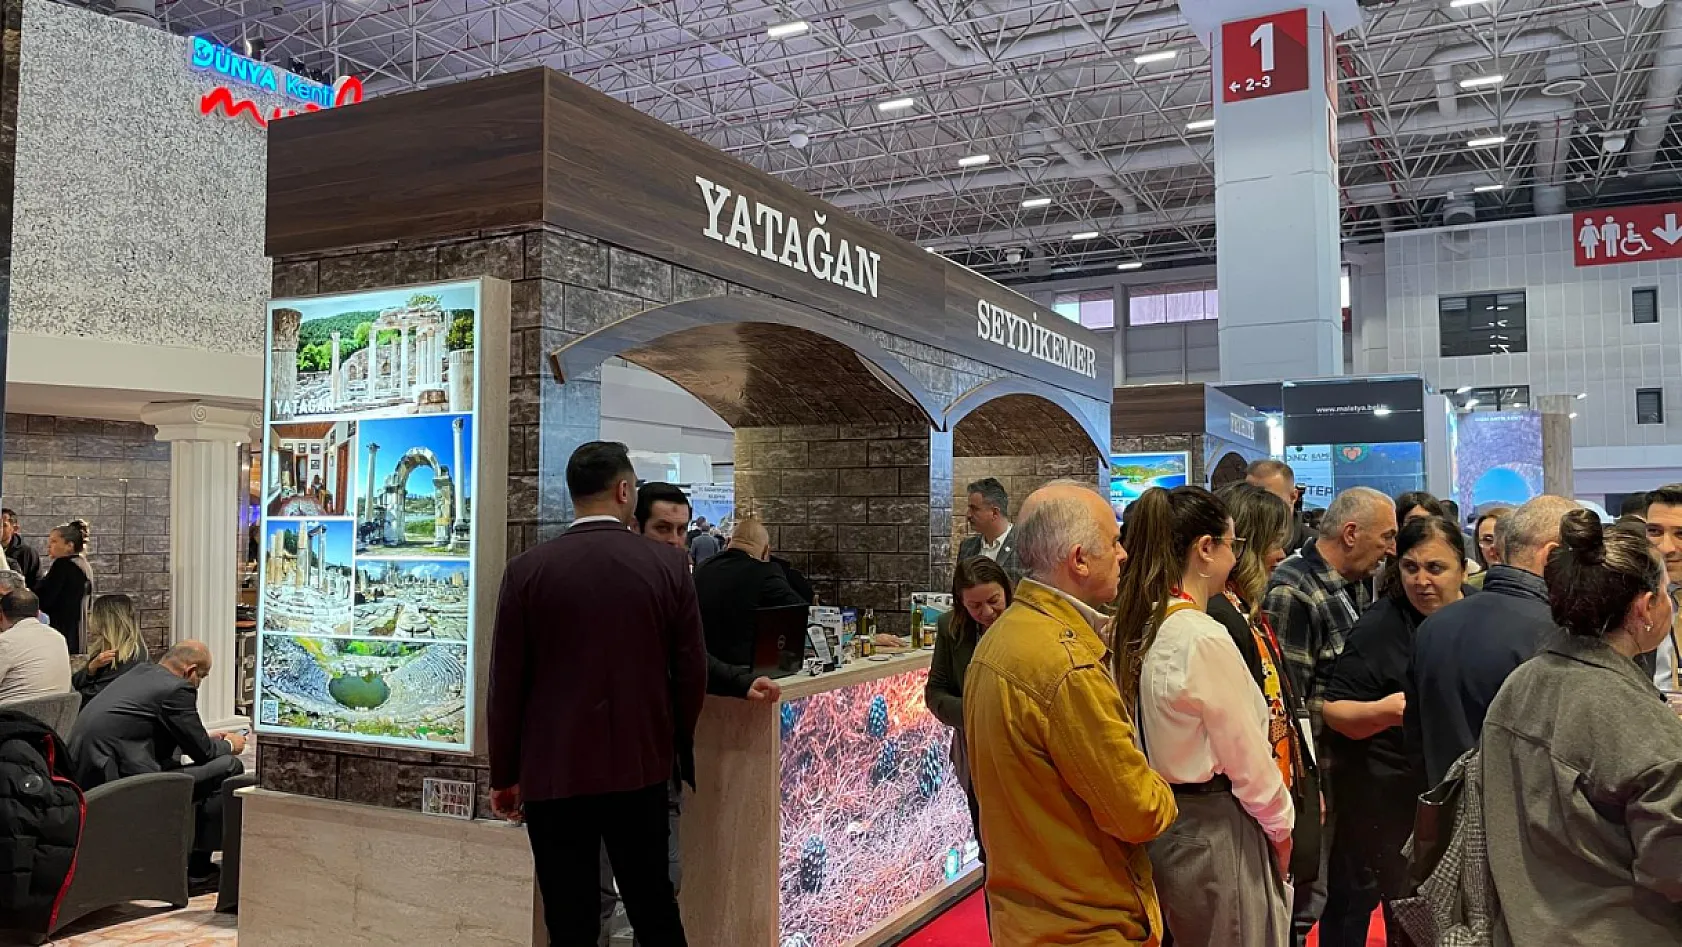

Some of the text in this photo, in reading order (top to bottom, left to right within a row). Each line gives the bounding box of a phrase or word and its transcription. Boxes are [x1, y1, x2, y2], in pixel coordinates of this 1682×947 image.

[192, 37, 276, 91] DÜNYA
[1250, 22, 1275, 72] 1
[1245, 75, 1272, 91] 2-3
[695, 175, 881, 298] YATAĞAN
[977, 299, 1097, 379] SEYDİKEMER
